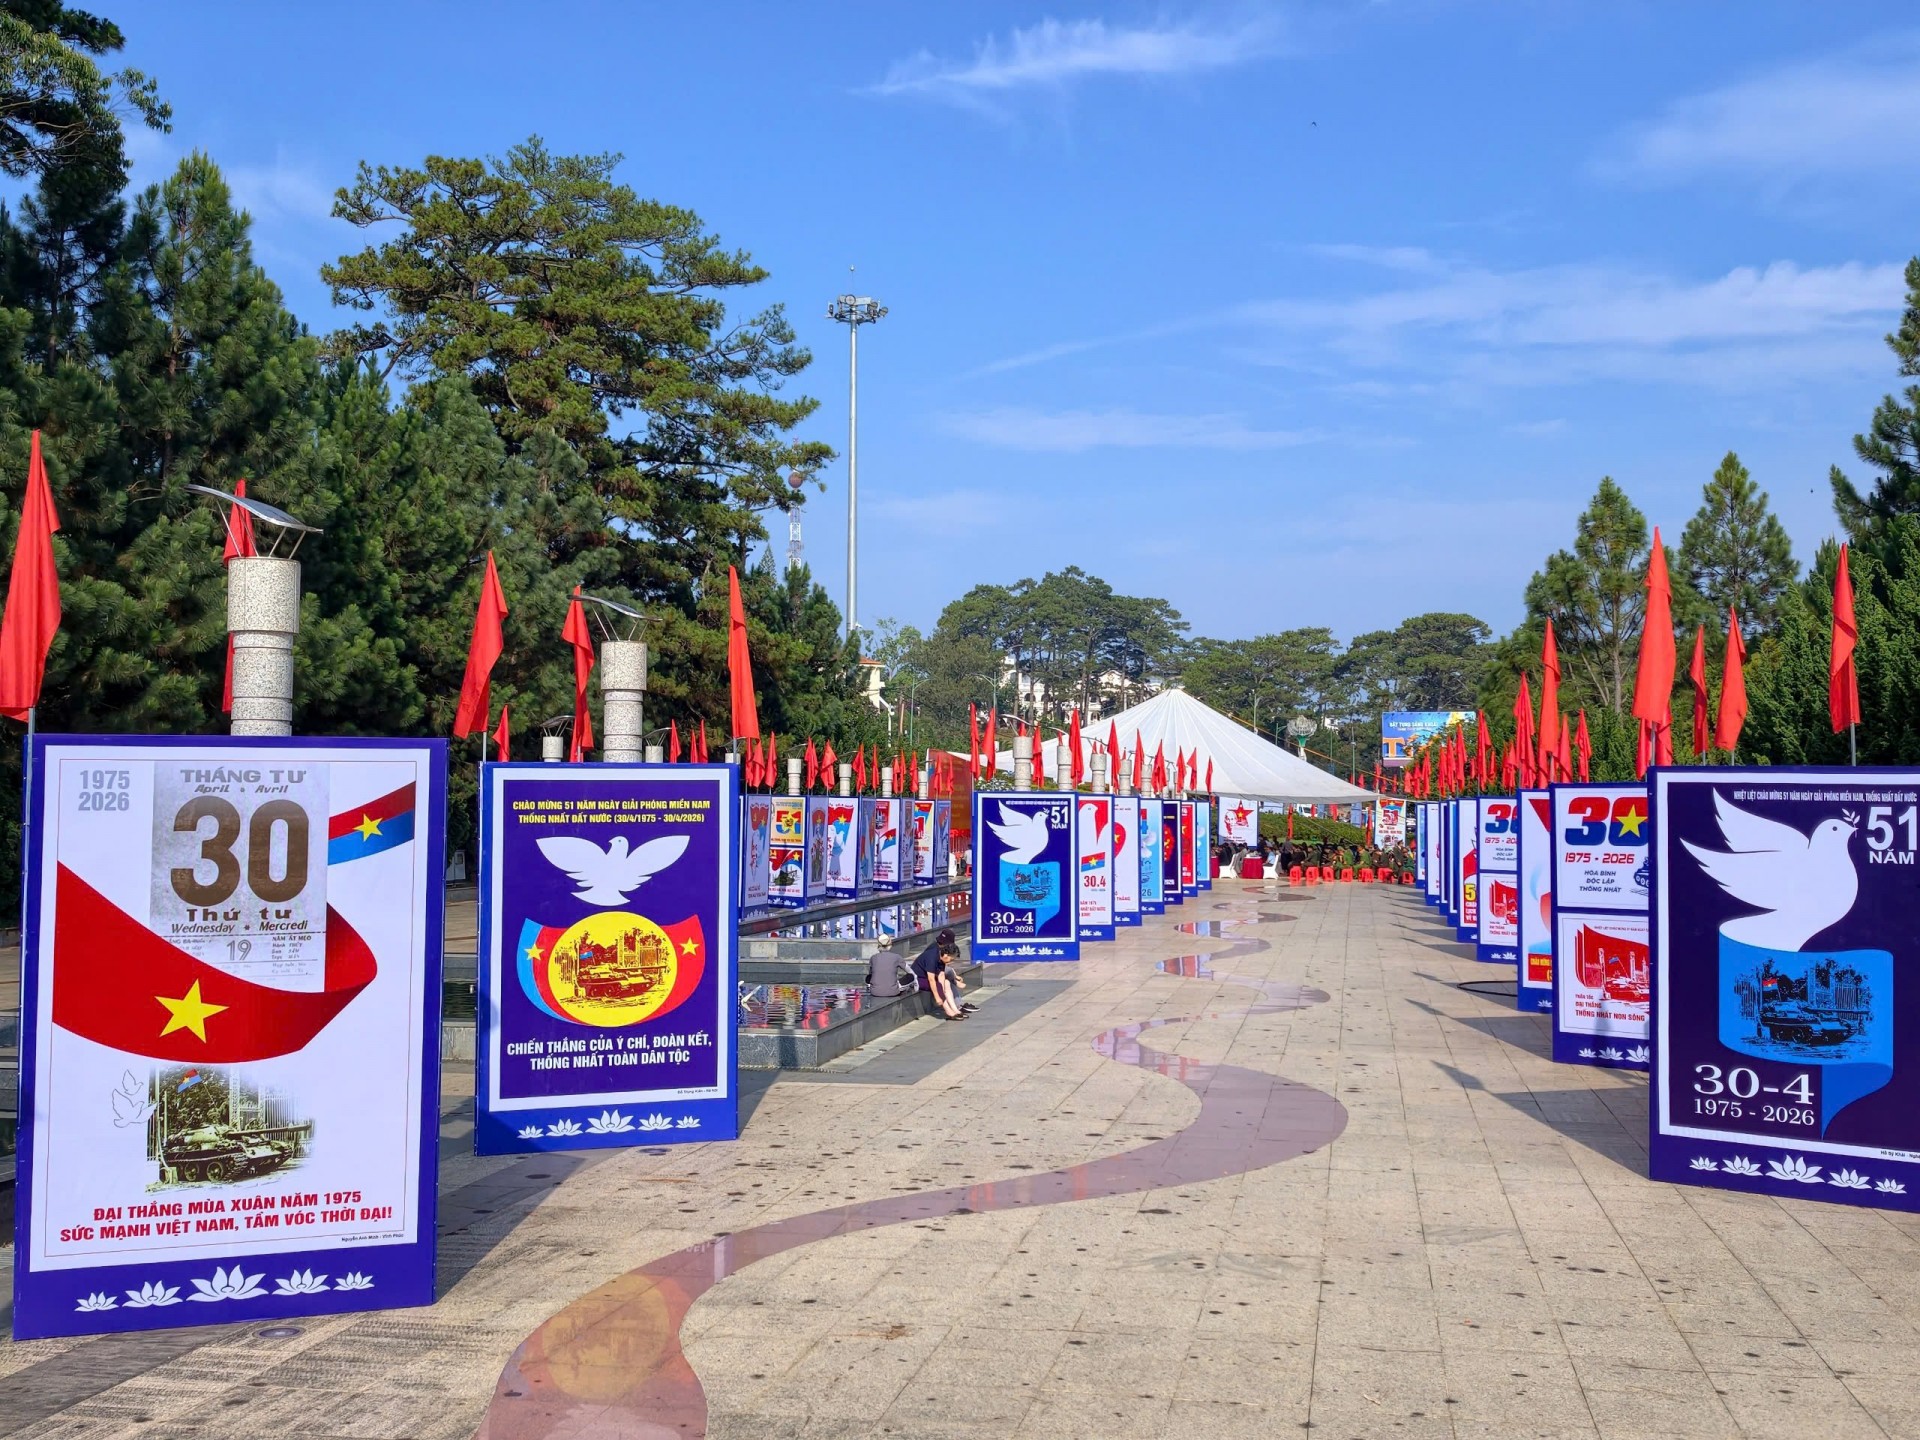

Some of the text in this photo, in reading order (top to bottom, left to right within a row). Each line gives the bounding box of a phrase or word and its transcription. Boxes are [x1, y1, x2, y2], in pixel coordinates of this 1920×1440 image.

[79, 770, 130, 790] 1975
[180, 766, 307, 784] THÁNG TƯ
[194, 784, 288, 794] April Avril
[1733, 789, 1747, 802] NHIỆT
[1747, 789, 1756, 802] LIỆT
[1756, 789, 1769, 800] CHÀO
[1769, 788, 1782, 800] MỪNG
[1783, 791, 1789, 800] 51
[1789, 790, 1801, 801] NĂM
[1801, 790, 1813, 801] NGÀY
[1813, 789, 1824, 802] GIẢI
[1823, 790, 1840, 802] PHÓNG
[1852, 792, 1865, 803] NAM,
[1865, 790, 1881, 802] THỐNG
[1881, 790, 1894, 802] NHẤT
[1894, 790, 1904, 802] ĐẤT
[1903, 791, 1918, 802] NƯỚC
[78, 791, 130, 811] 2026
[512, 799, 536, 810] CHÀO
[537, 799, 563, 810] MỪNG
[564, 801, 574, 810] 51
[576, 799, 596, 810] NĂM
[598, 799, 620, 810] NGÀY
[622, 798, 638, 810] GIẢI
[640, 799, 667, 809] PHÓNG
[691, 800, 710, 809] NAM
[518, 812, 546, 823] THỐNG
[548, 812, 570, 823] NHẤT
[572, 812, 587, 823] ĐẤT
[589, 813, 612, 823] NƯỚC
[614, 814, 656, 823] (30/4/1975
[663, 813, 705, 823] 30/4/2026)
[776, 810, 801, 834] 51
[1051, 806, 1068, 824] 51
[1866, 806, 1917, 851] 51
[170, 795, 309, 907] 30
[1565, 852, 1591, 863] 1975
[1602, 853, 1635, 864] 2026
[1869, 848, 1915, 865] NĂM
[1084, 875, 1106, 888] 30.4
[1603, 885, 1622, 893] NHẤT
[187, 907, 292, 922] Thứ tư
[990, 911, 1034, 925] 30-4
[171, 921, 308, 934] Wednesday Mercredi
[990, 926, 1008, 934] 1975
[1015, 925, 1034, 933] 2026
[226, 939, 252, 961] 19
[1575, 1009, 1645, 1021] THỐNG NHẤT NON SÔNG
[507, 1030, 712, 1055] CHIẾN THẮNG CỦA Ý CHÍ, ĐOÀN KẾT,
[530, 1048, 690, 1070] THỐNG NHẤT TOÀN DÂN TỘC
[1694, 1064, 1815, 1104] 30-4
[1694, 1098, 1742, 1118] 1975
[1762, 1105, 1815, 1126] 2026
[93, 1191, 361, 1223] ĐẠI THẮNG MÙA XUÂN NĂM 1975
[60, 1206, 392, 1242] SỨC MẠNH VIỆT NAM, TẦM VÓC THỜI ĐẠI!
